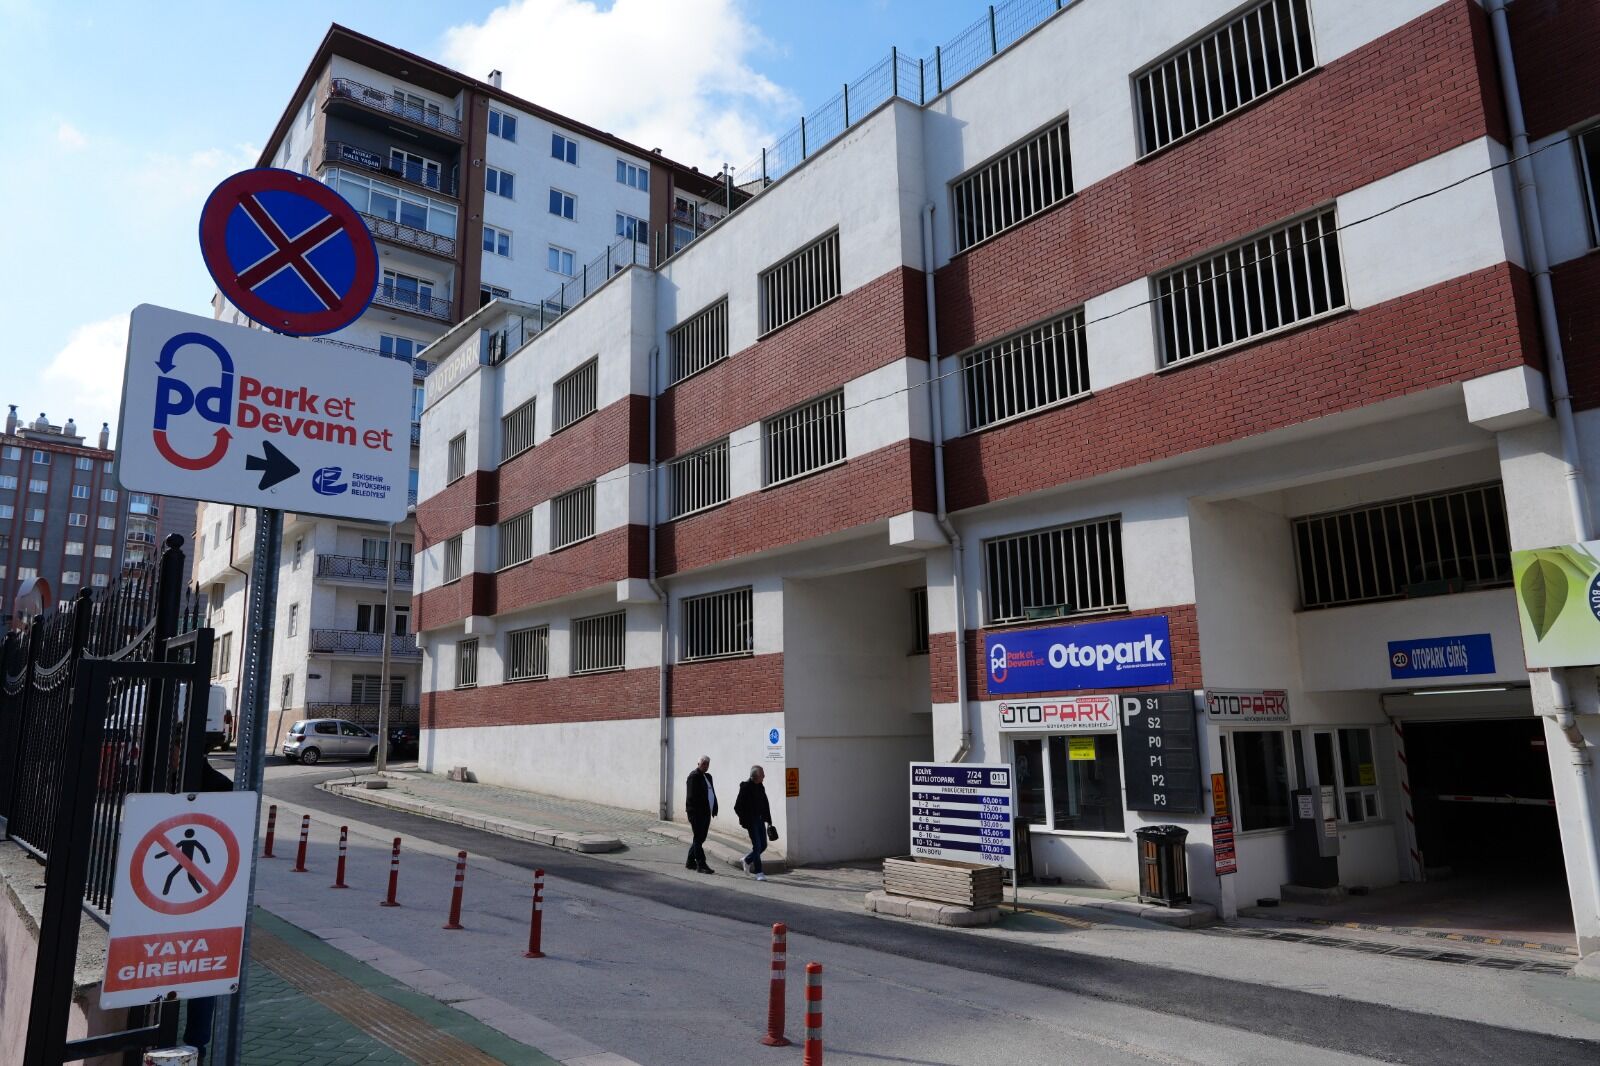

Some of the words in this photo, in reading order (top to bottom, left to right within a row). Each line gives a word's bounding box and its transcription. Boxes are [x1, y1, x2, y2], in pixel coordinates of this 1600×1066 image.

[239, 376, 319, 414] Park
[324, 397, 355, 420] et
[237, 402, 357, 446] Devam
[363, 429, 393, 451] et
[1008, 650, 1025, 659] Park
[1048, 634, 1166, 671] Otopark
[1395, 655, 1406, 665] 20
[1411, 646, 1446, 670] OTOPARK
[1446, 640, 1468, 672] GİRİŞ
[1008, 660, 1035, 668] Devam
[1146, 698, 1158, 710] S1
[1210, 696, 1286, 714] OTOPARK
[1002, 703, 1110, 723] OTOPARK
[1122, 698, 1141, 726] P
[1148, 717, 1160, 728] S2
[1149, 736, 1161, 748] P0
[1150, 756, 1162, 766] P1
[1152, 775, 1165, 786] P2
[1154, 794, 1166, 805] P3
[144, 938, 208, 957] YAYA
[118, 956, 228, 981] GİREMEZ
